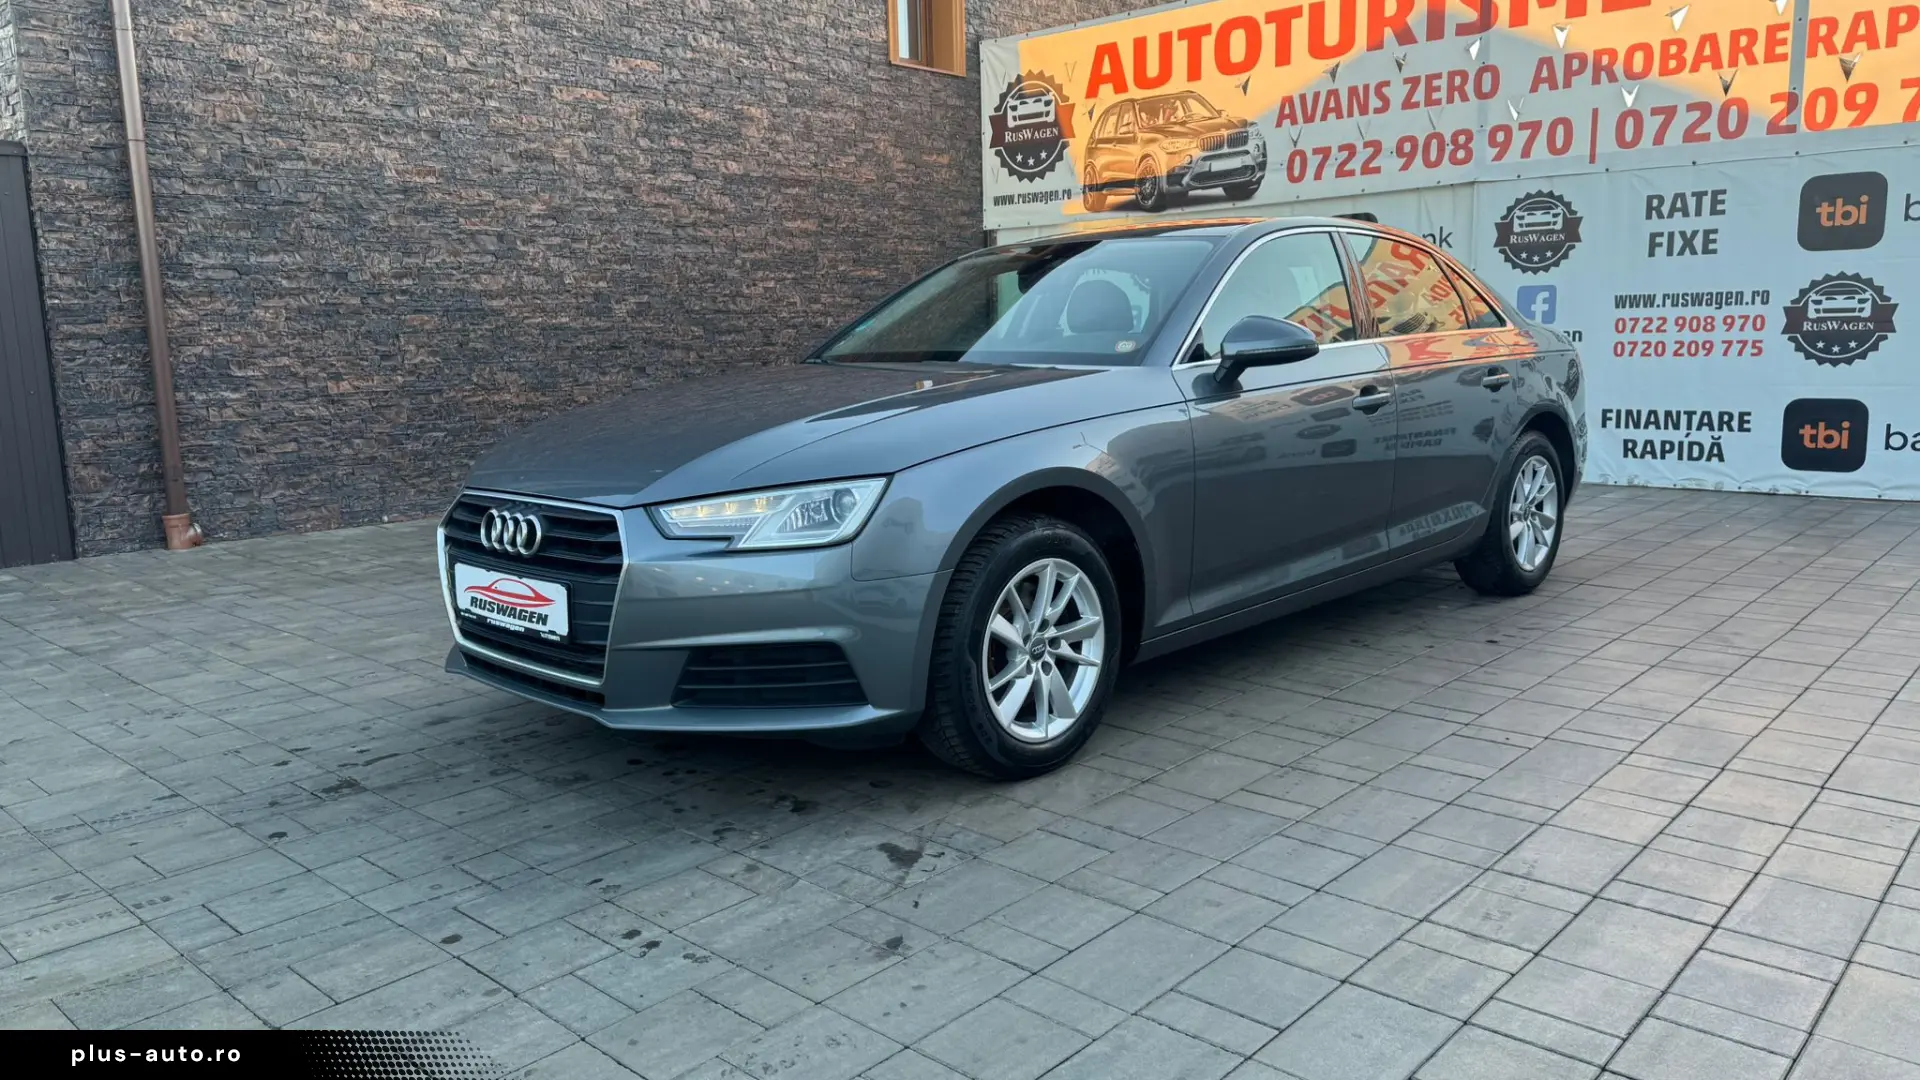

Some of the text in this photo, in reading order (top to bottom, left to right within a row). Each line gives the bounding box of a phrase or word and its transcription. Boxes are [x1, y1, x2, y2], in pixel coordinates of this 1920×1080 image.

[1274, 4, 1920, 128] AVANS ZERO APROBARE RAP
[1286, 139, 1383, 184] 0722
[1395, 128, 1474, 172] 908
[1487, 116, 1574, 162] 970
[1614, 97, 1750, 150] 0720
[1765, 82, 1880, 136] 209
[993, 188, 1072, 207] www.ruswagen.ro
[1644, 188, 1728, 221] RATE
[1815, 195, 1870, 227] tbi
[1647, 228, 1720, 258] FIXE
[1614, 289, 1771, 310] www.ruswagen.ro
[1614, 314, 1767, 334] 0722 908 970
[1612, 339, 1764, 358] 0720 209 775
[1798, 420, 1851, 450] tbi
[469, 595, 549, 627] RUSWAGEN
